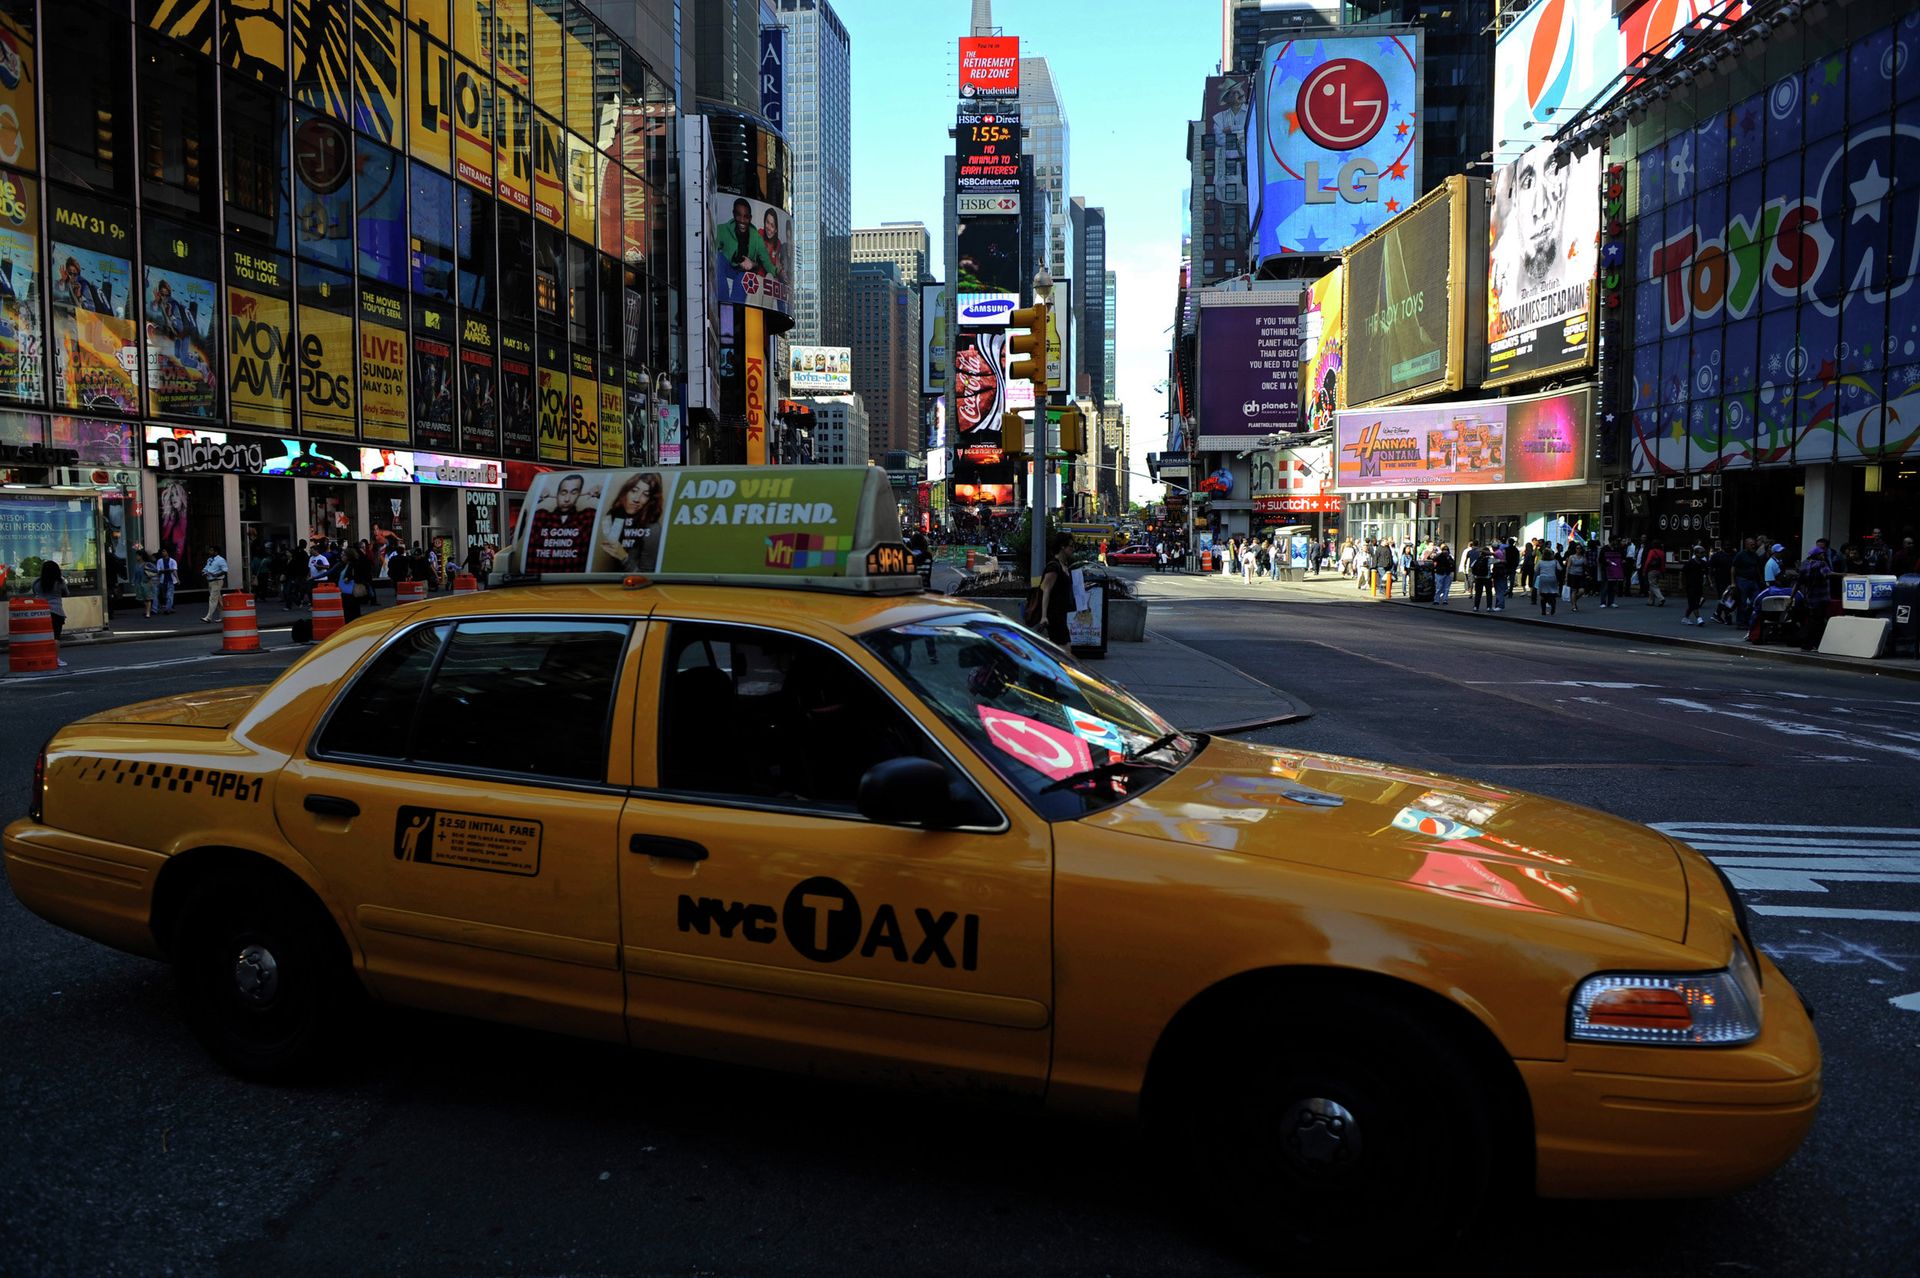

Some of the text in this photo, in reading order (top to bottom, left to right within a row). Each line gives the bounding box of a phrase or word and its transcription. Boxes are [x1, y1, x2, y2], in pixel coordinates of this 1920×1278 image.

[963, 58, 1016, 68] RETIREMENT
[970, 68, 988, 79] RED
[976, 86, 1018, 95] Prudential
[958, 115, 1019, 124] HSBC Direct
[983, 145, 996, 154] NO
[1001, 155, 1011, 165] TO
[459, 164, 493, 188] ENTRANCE
[960, 165, 1019, 175] EARN INTEREST
[957, 178, 1020, 186] HSBCdirect.com
[1304, 157, 1379, 205] LG
[500, 184, 529, 206] ON 45TH
[535, 200, 553, 219] STREET
[960, 200, 997, 210] HSBC
[55, 207, 87, 230] MAY
[90, 217, 105, 235] 31
[234, 251, 278, 275] THE HOST
[1652, 204, 1821, 327] TOYS
[235, 265, 280, 288] YOU LOVE.
[362, 291, 400, 311] THE MOVIES
[969, 304, 1009, 313] SAMSUNG
[1401, 291, 1424, 321] TOYS
[1496, 306, 1519, 335] JESSE
[1517, 298, 1541, 330] JAMES
[1547, 288, 1567, 319] DEAD
[1566, 283, 1585, 313] MAN
[1255, 317, 1297, 325] IF YOU THINK
[1261, 328, 1288, 336] NOTHING
[362, 334, 404, 366] LIVE!
[1258, 339, 1281, 347] PLANET
[363, 362, 404, 383] SUNDAY
[1249, 361, 1262, 369] YOU
[1273, 371, 1287, 379] NEW
[363, 379, 393, 396] MAY 31
[1262, 382, 1278, 390] ONCE
[1279, 382, 1287, 390] IN
[747, 358, 763, 442] Kodak
[1261, 401, 1289, 411] planet
[1343, 422, 1418, 459] HANNAH
[163, 438, 264, 474] Billabong
[436, 460, 488, 484] element
[680, 479, 737, 500] ADD
[467, 491, 497, 506] POWER
[1267, 498, 1310, 511] swatch
[15, 514, 25, 522] ON
[476, 505, 489, 520] TO
[673, 504, 709, 526] AS
[712, 504, 728, 525] A
[13, 523, 22, 531] IN
[475, 520, 491, 534] THE
[541, 528, 579, 537] IS GOING
[468, 533, 499, 548] PLANET
[544, 538, 573, 547] BEHIND
[536, 549, 579, 558] THE MUSIC
[879, 547, 905, 571] 9P61
[439, 816, 536, 838] $2.50 INITIAL FARE
[678, 893, 979, 971] NYC TAXI
